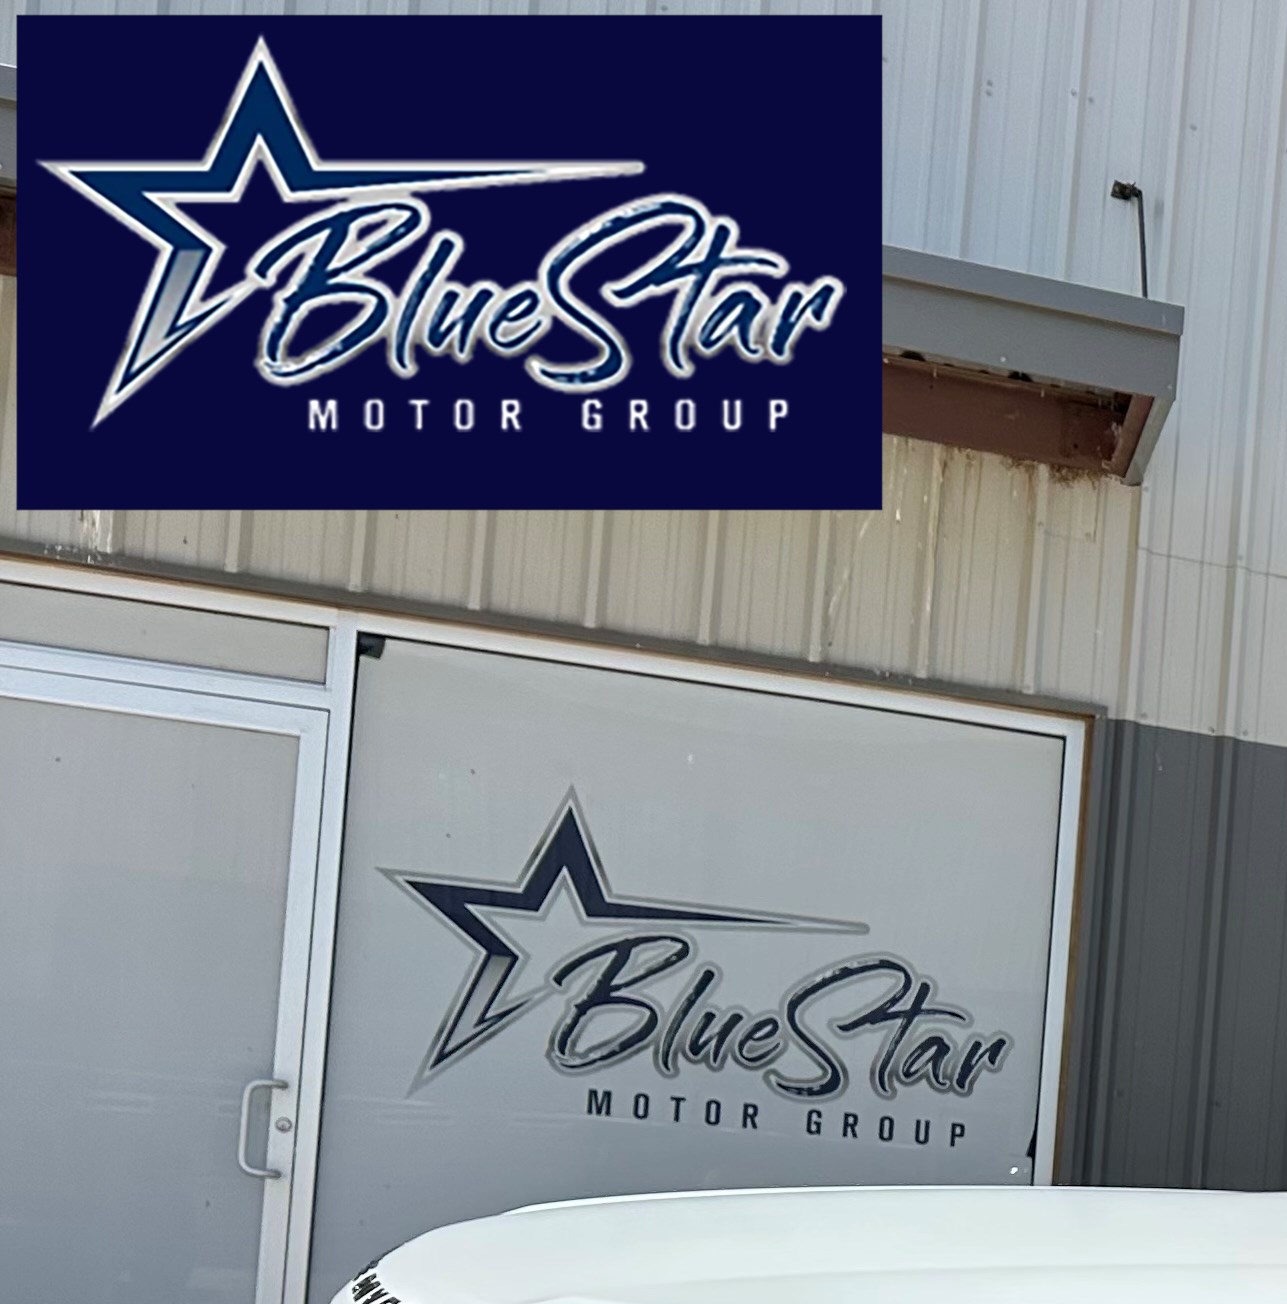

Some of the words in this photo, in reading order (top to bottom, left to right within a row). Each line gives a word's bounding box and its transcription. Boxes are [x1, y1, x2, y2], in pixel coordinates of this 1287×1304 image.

[549, 932, 1011, 1100] BlueStar
[586, 1089, 759, 1130] MOTOR
[805, 1108, 967, 1149] GROUP
